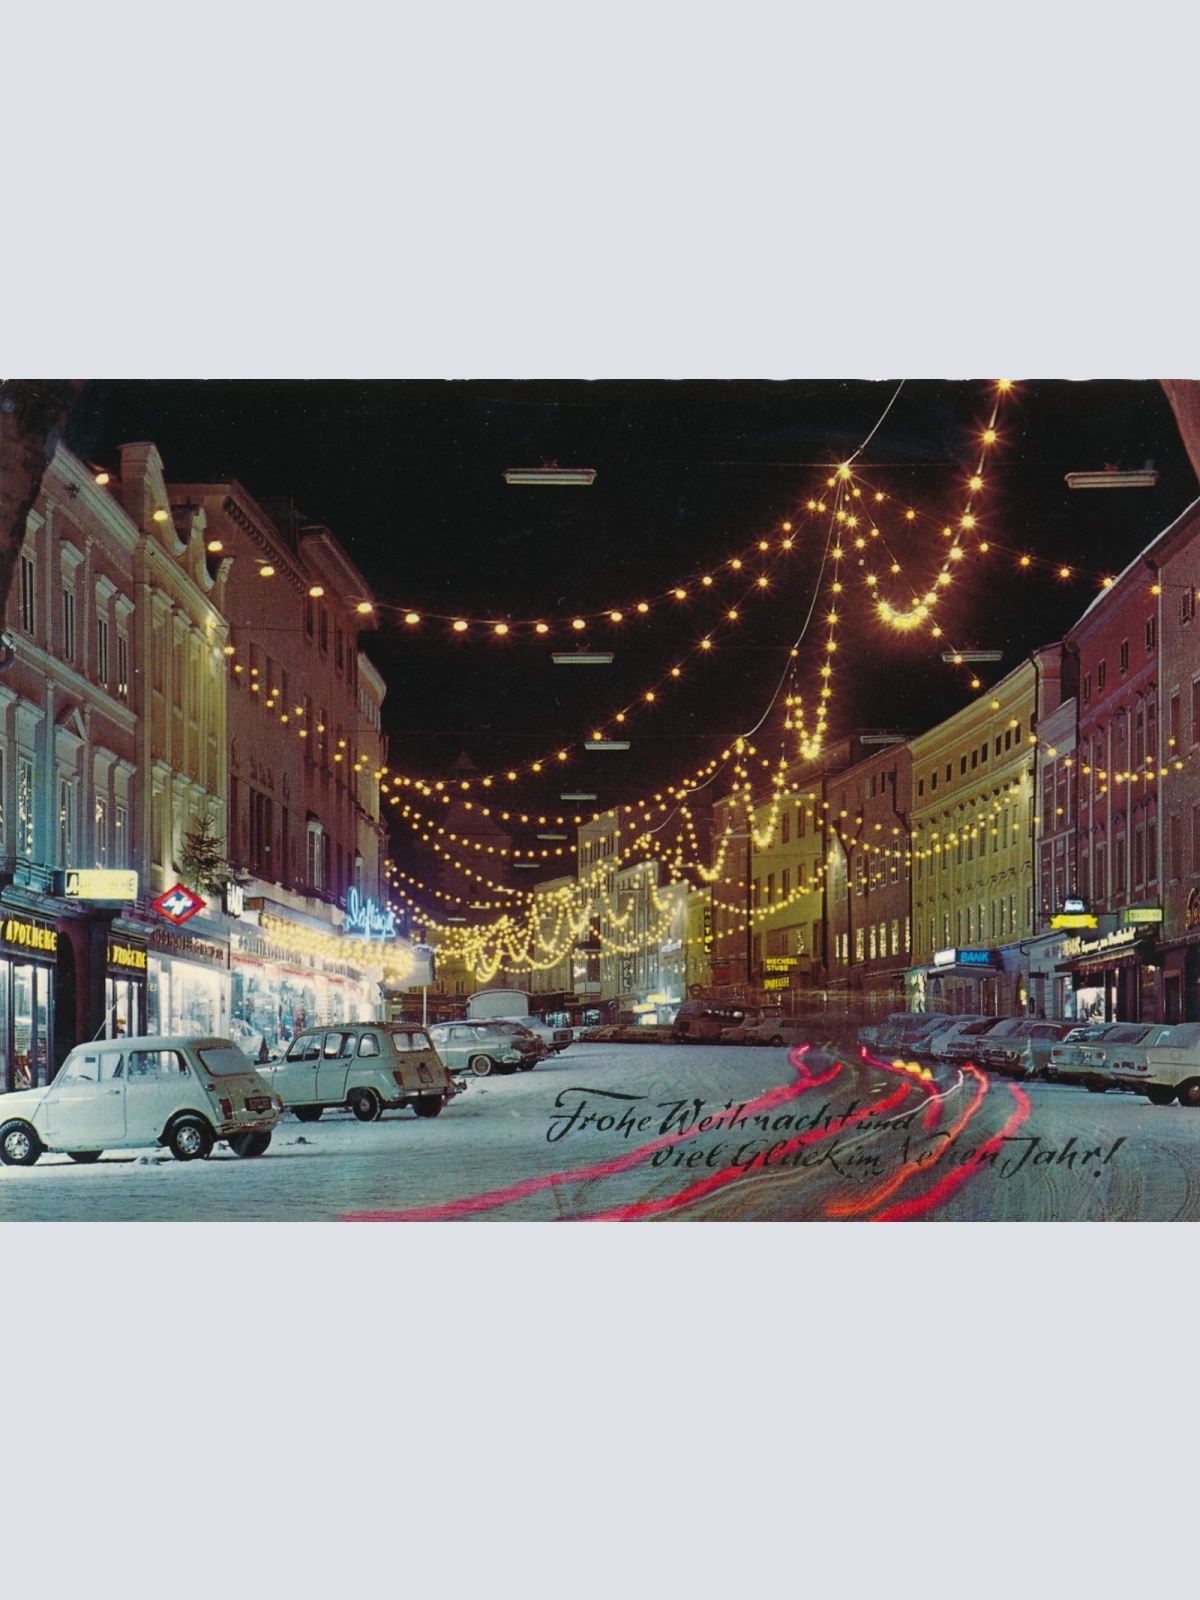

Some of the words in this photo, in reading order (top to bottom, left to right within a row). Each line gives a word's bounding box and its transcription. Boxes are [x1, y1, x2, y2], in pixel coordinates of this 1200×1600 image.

[5, 919, 58, 952] APOTHEKE
[112, 945, 147, 969] DROGERIE
[960, 951, 989, 963] BANK
